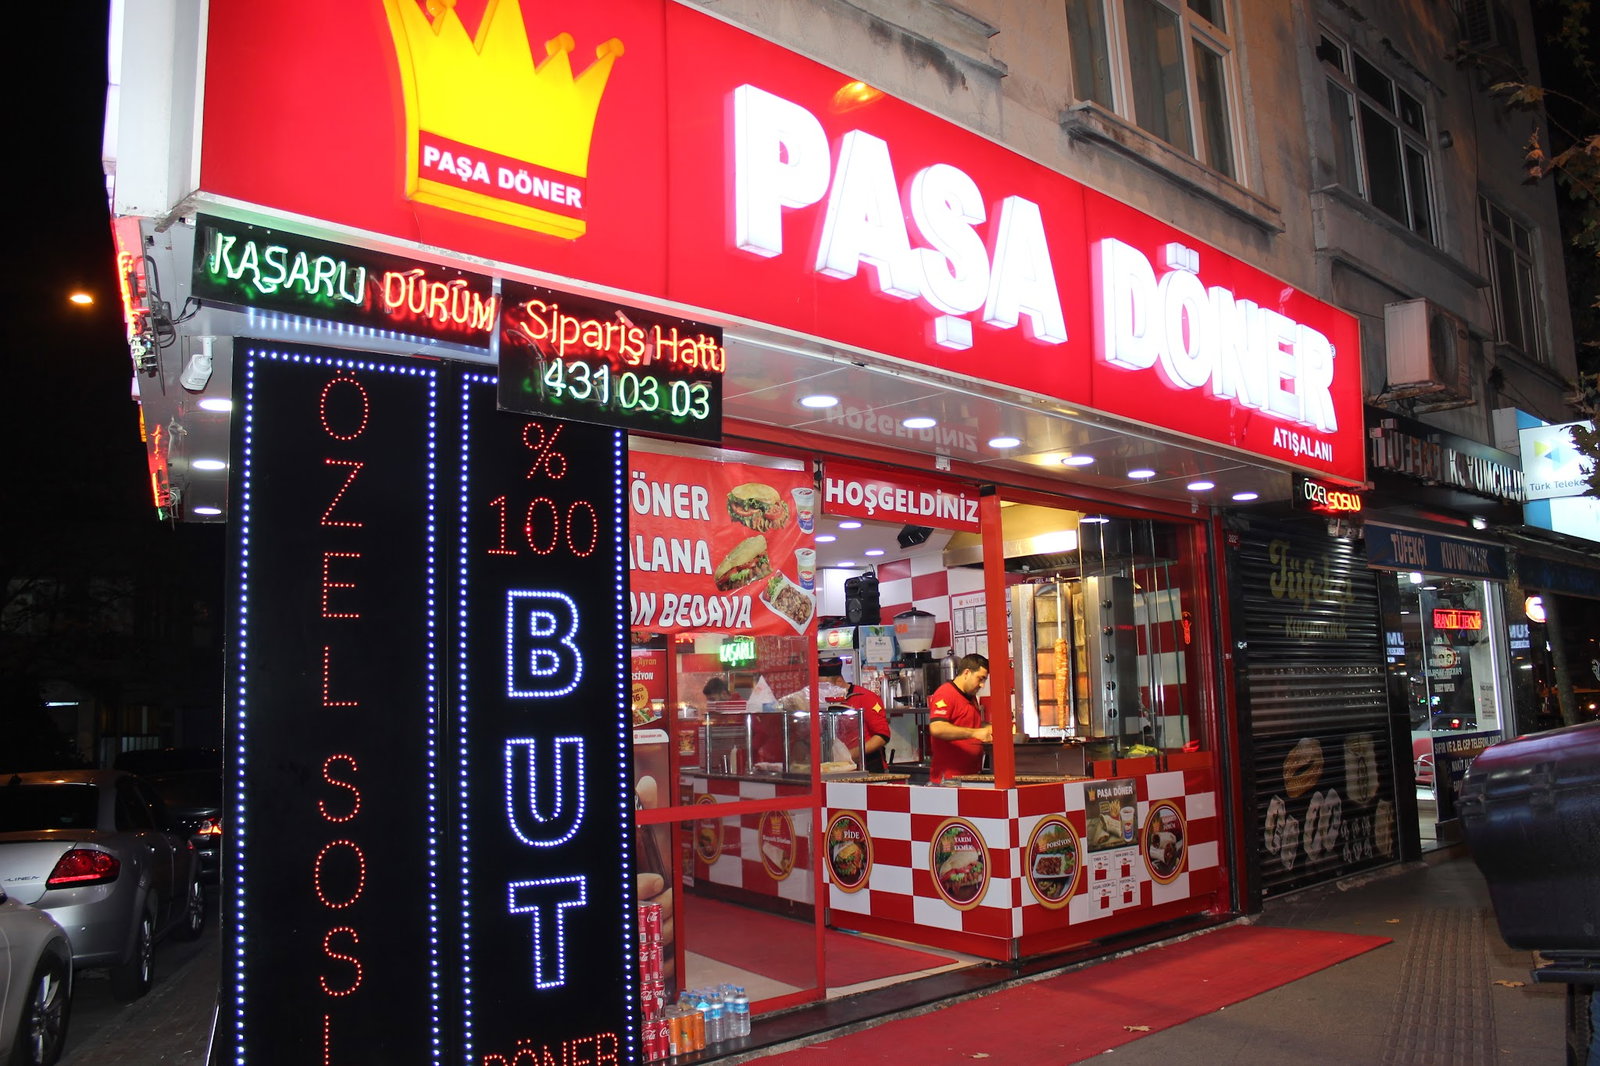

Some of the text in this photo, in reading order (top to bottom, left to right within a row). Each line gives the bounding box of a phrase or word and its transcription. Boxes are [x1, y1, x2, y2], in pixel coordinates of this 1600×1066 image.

[423, 145, 582, 208] PAŞA DÖNER
[734, 84, 1338, 432] PAŞA DÖNER
[520, 300, 645, 365] Sipariş
[544, 357, 709, 419] 431 03 03
[1273, 427, 1333, 462] ATIŞALANI
[629, 471, 711, 520] ÖNER
[825, 477, 980, 523] HOŞGELDİNİZ
[1303, 477, 1328, 504] ÖZEL
[1529, 482, 1551, 491] Türk
[488, 495, 599, 557] 100
[1390, 531, 1427, 570] TÜFEKÇİ
[658, 593, 753, 629] BEDAVA
[1097, 785, 1133, 799] PAŞA DÖNER
[844, 829, 860, 840] PİDE
[484, 1033, 618, 1066] NER
